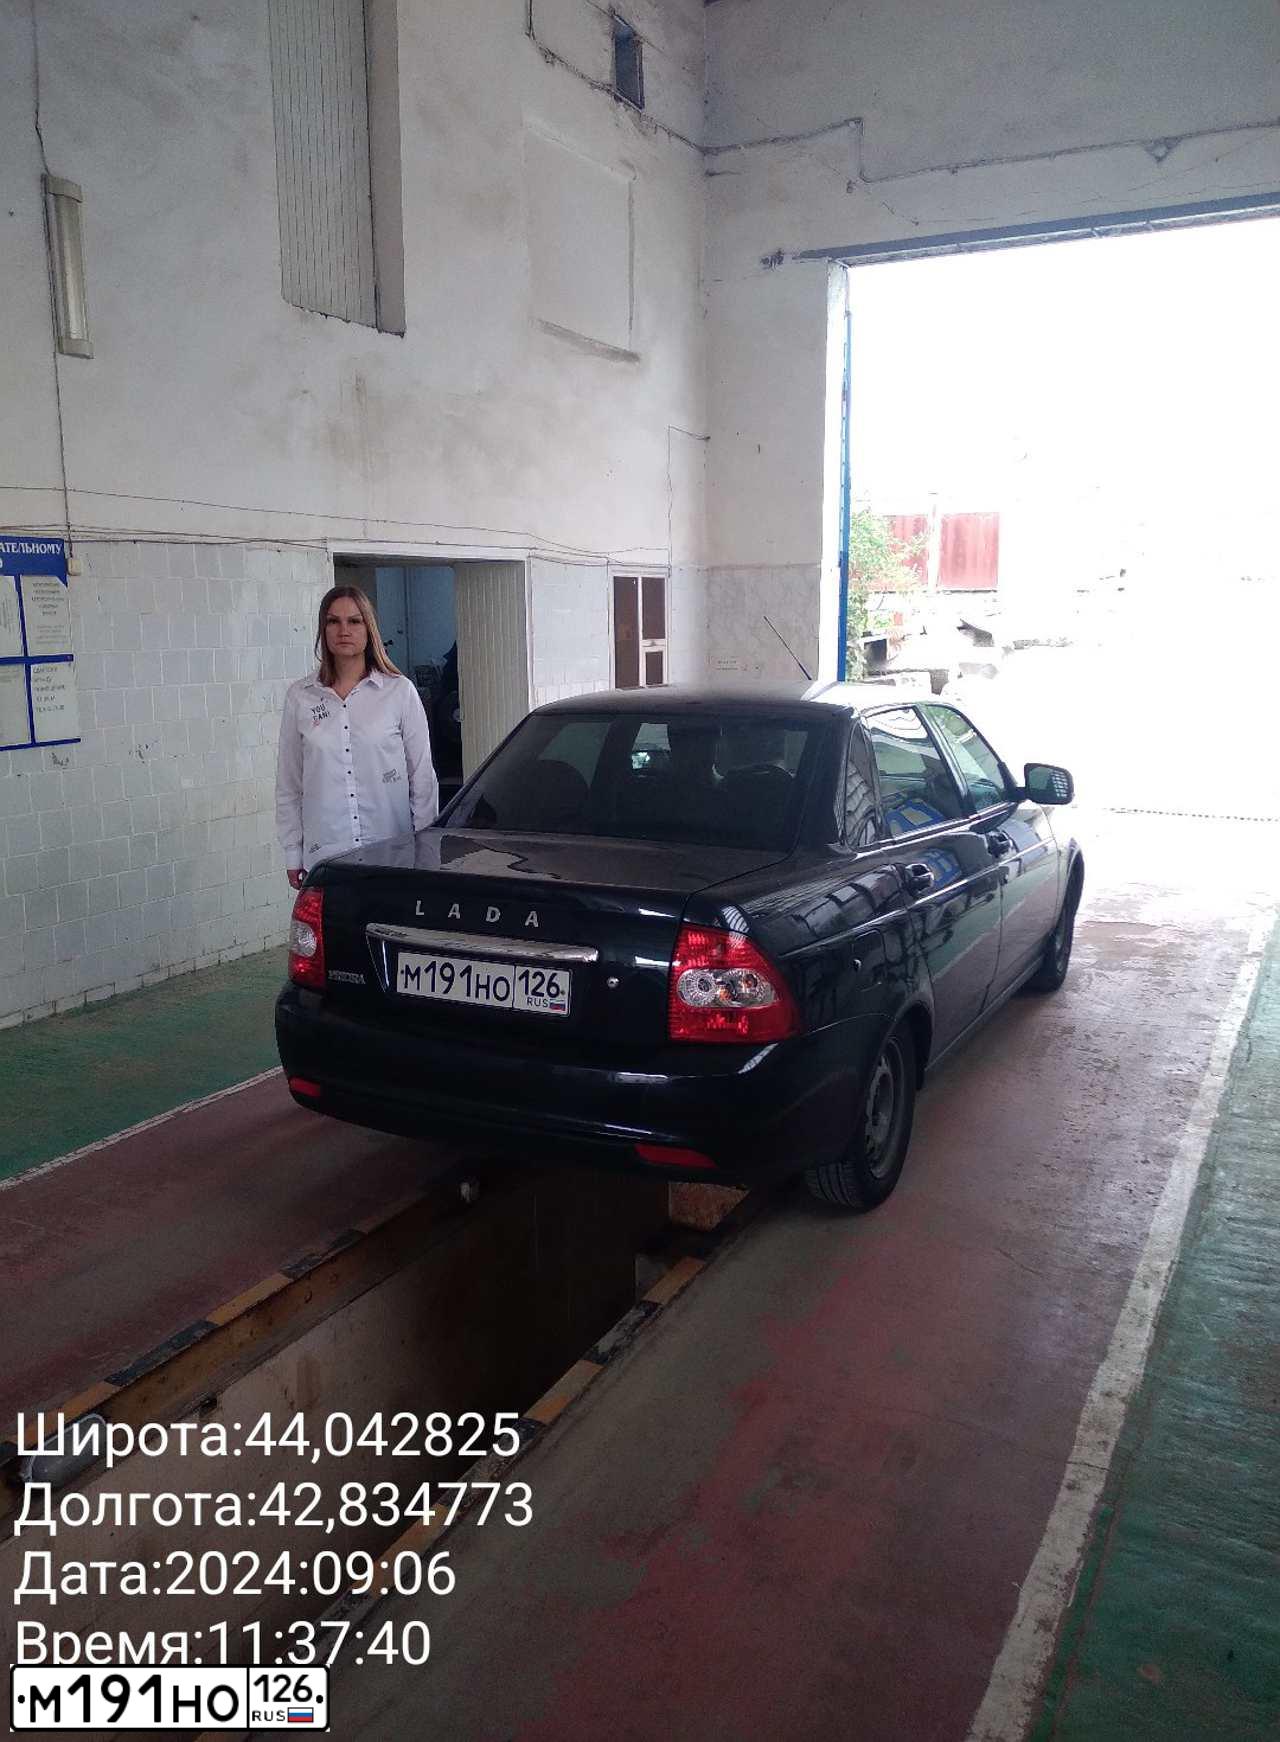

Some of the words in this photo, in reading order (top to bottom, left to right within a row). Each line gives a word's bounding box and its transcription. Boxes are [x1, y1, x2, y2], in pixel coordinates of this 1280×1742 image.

[415, 900, 539, 928] LADA
[518, 969, 561, 999] 126
[526, 997, 549, 1008] RUS
